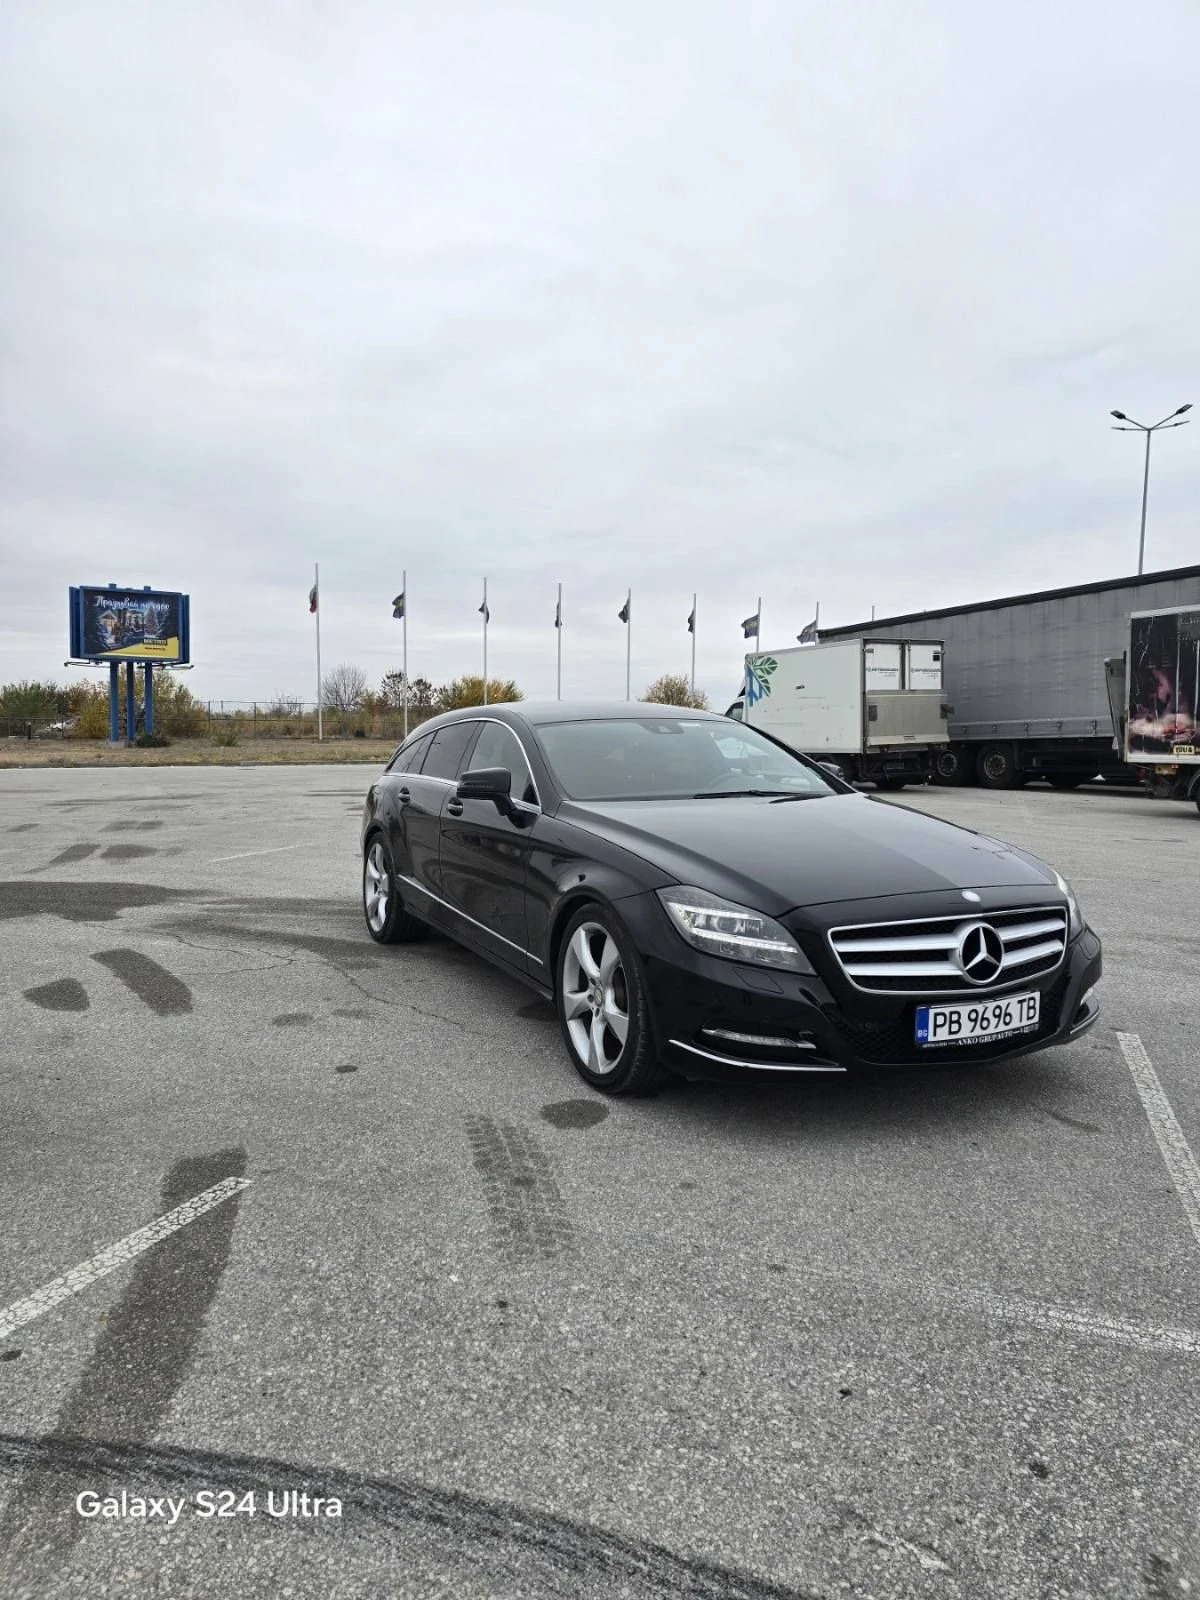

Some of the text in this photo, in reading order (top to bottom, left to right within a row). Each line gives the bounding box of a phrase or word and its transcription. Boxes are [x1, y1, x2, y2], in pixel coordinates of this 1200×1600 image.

[932, 1011, 963, 1037] PB
[967, 1002, 1013, 1033] 9696
[1017, 997, 1037, 1023] TB
[917, 1030, 928, 1038] BG
